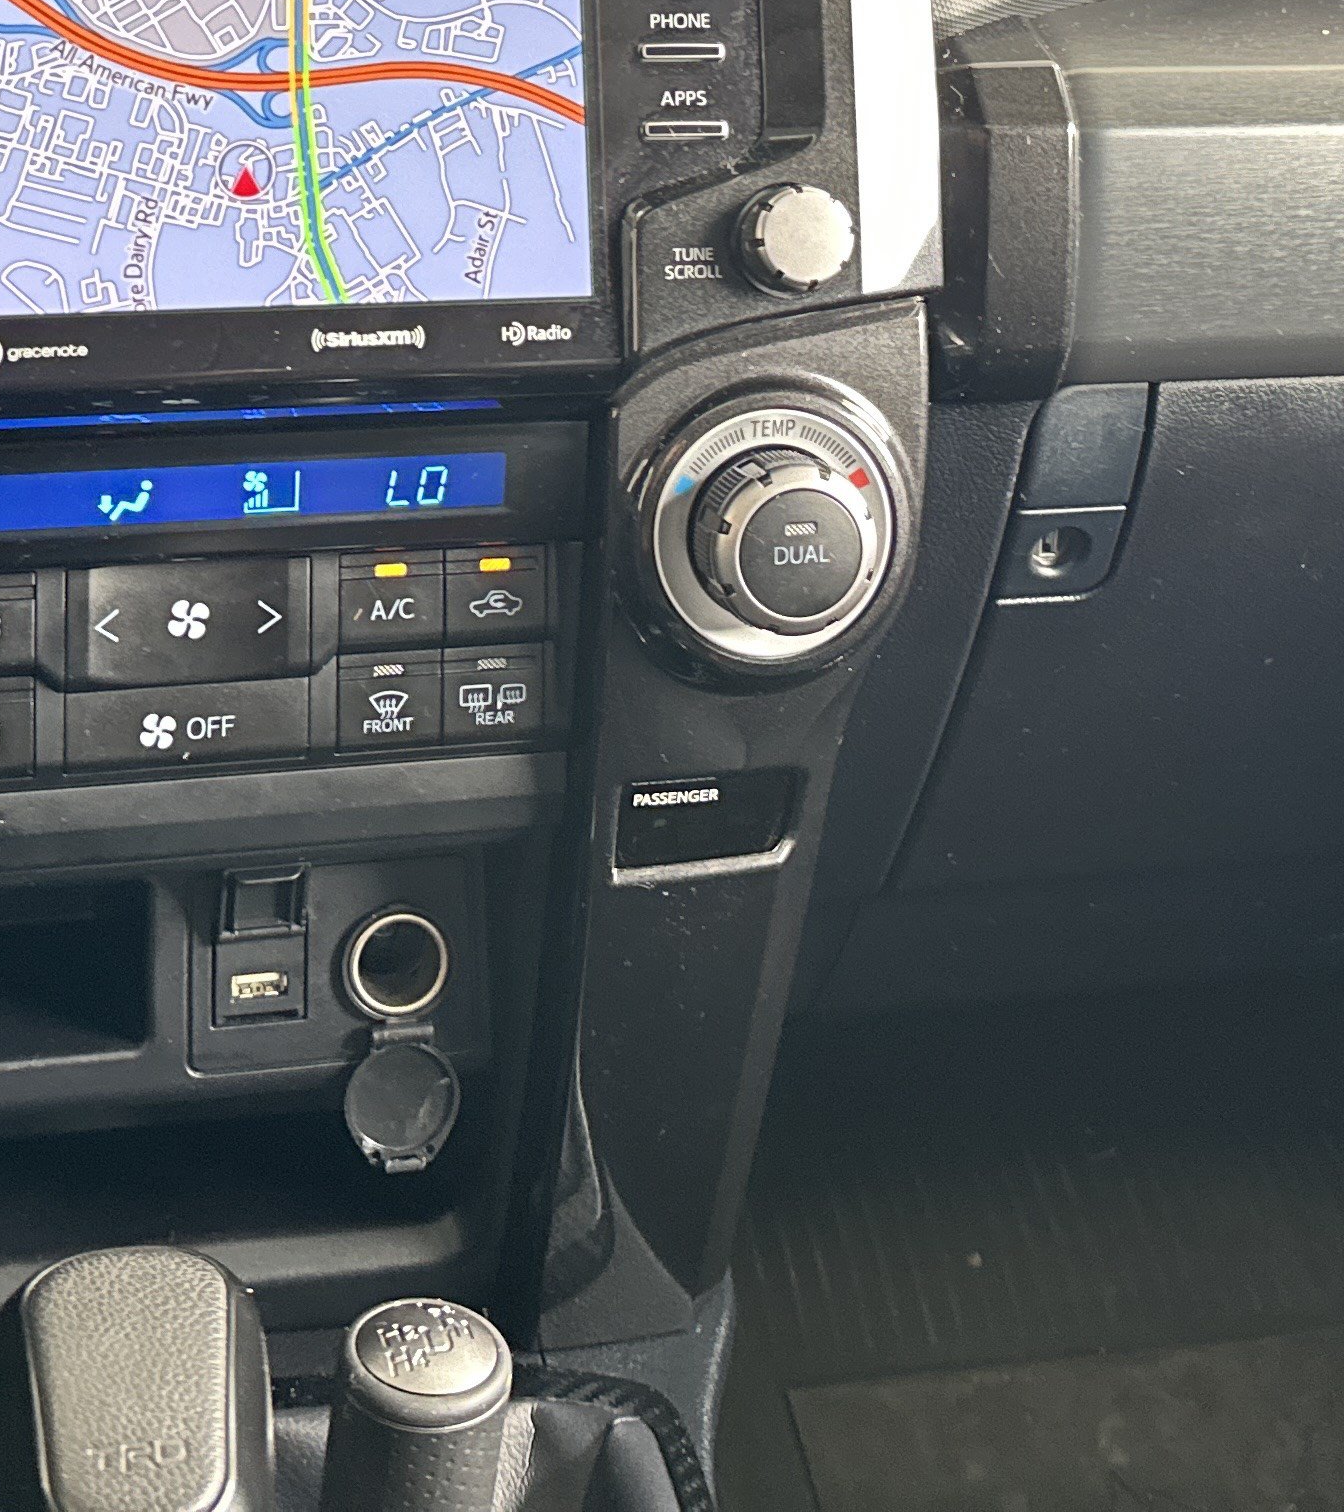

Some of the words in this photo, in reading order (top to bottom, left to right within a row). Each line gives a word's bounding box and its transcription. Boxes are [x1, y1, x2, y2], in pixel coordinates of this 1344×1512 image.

[649, 12, 711, 29] PHONE
[49, 39, 78, 65] All
[78, 53, 167, 99] American
[171, 84, 214, 110] Fwy
[660, 90, 707, 107] APPS
[135, 196, 159, 224] Rd
[123, 228, 152, 279] Dairy
[464, 234, 490, 285] Adair
[477, 210, 499, 232] St
[672, 246, 714, 262] TUNE
[664, 263, 723, 280] SCROLL
[528, 324, 572, 341] Radio
[6, 343, 89, 362] gracenote
[749, 418, 796, 438] TEMP
[773, 544, 830, 566] DUAL
[370, 597, 415, 621] A/C
[185, 714, 236, 740] OFF
[362, 716, 415, 734] FRONT
[475, 709, 515, 726] REAR
[632, 788, 719, 807] PASSENGER
[85, 1438, 188, 1473] TRD
